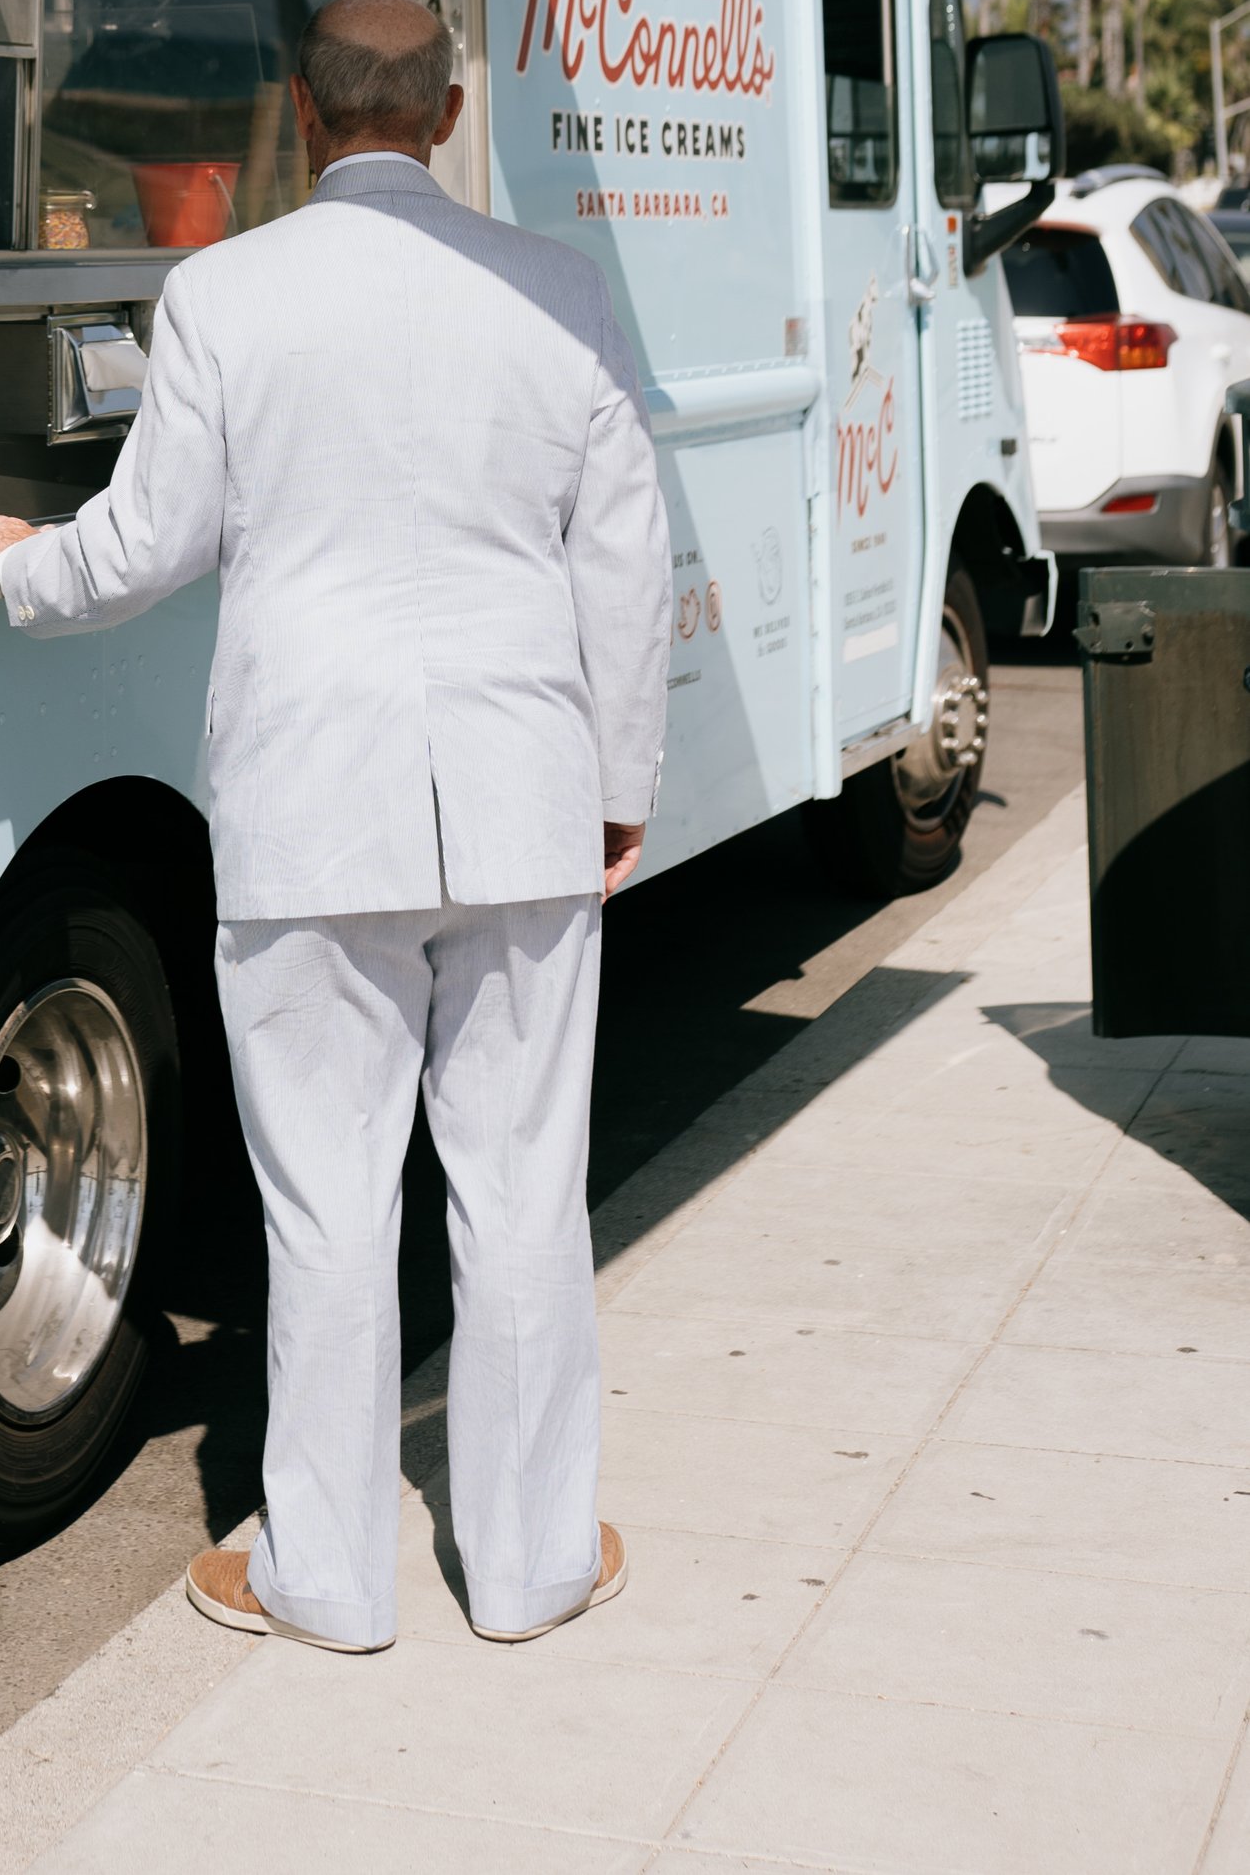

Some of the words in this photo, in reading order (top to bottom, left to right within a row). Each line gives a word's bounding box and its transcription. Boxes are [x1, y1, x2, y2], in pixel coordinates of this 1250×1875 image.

[552, 112, 604, 152] FINE
[616, 117, 649, 154] ICE
[661, 121, 745, 159] CREAMS
[576, 190, 626, 217] SANTA
[712, 193, 729, 217] CA
